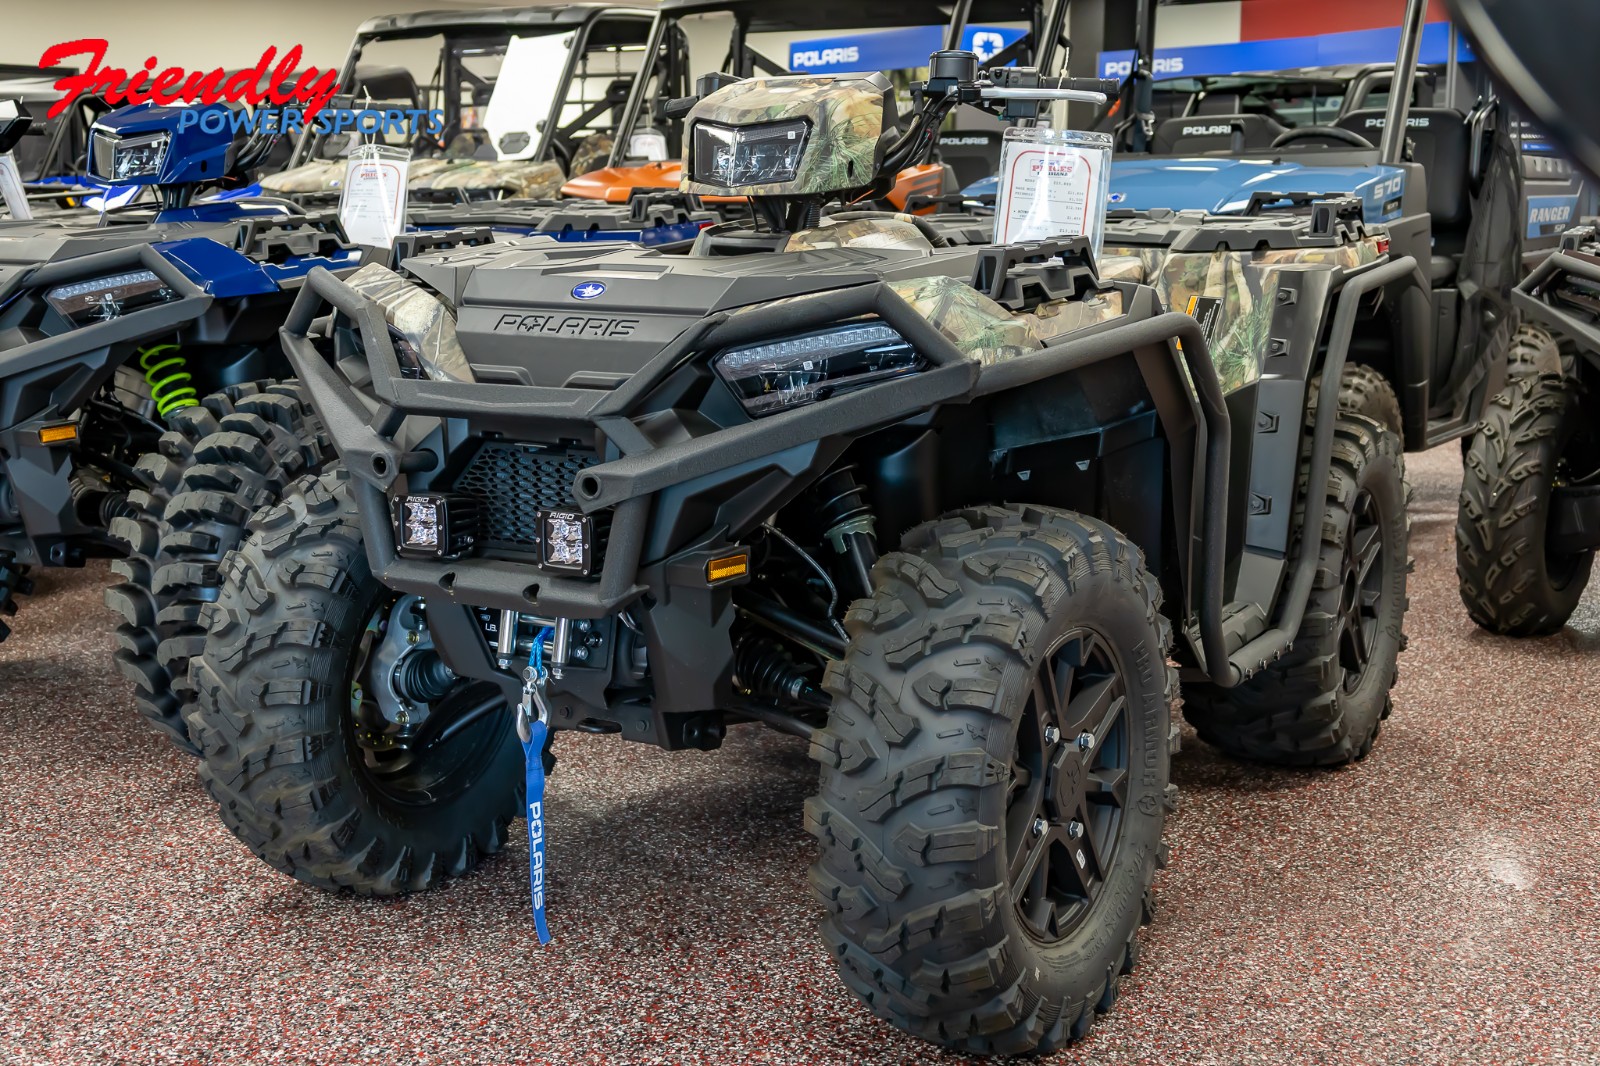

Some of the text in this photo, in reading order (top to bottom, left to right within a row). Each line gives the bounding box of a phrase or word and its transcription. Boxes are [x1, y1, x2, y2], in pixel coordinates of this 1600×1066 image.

[793, 46, 859, 68] POLARIS
[1105, 57, 1184, 76] PORIS
[1365, 117, 1430, 128] PORIS
[1182, 125, 1232, 136] POLARI
[939, 136, 989, 146] POLARIS
[1529, 206, 1571, 224] RANGER
[493, 312, 641, 338] POLARIS
[406, 495, 430, 503] RIGID
[549, 511, 575, 520] RIGID
[530, 801, 544, 911] POLARIS
